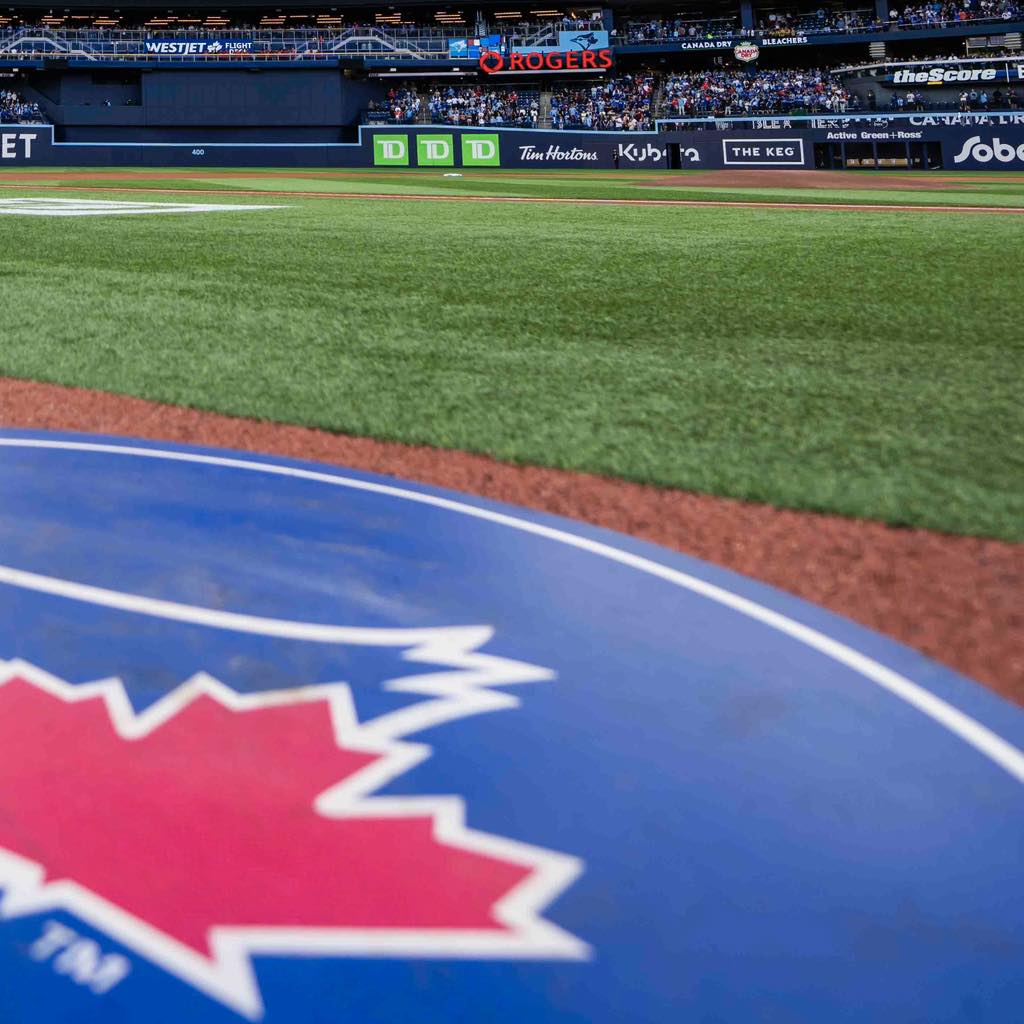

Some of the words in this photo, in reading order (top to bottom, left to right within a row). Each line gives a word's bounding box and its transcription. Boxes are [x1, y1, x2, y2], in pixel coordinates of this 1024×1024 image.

[145, 42, 207, 55] WESTJET
[717, 40, 732, 48] DRY
[762, 36, 808, 45] BLEACHERS
[510, 49, 613, 70] ROGERS
[892, 68, 997, 84] theScore
[827, 131, 857, 140] Active
[377, 140, 405, 159] TD
[420, 140, 449, 160] TD
[465, 140, 495, 160] TD
[519, 145, 544, 161] Tim
[732, 147, 761, 157] THE
[766, 147, 794, 157] KEG
[28, 919, 132, 995] TM
